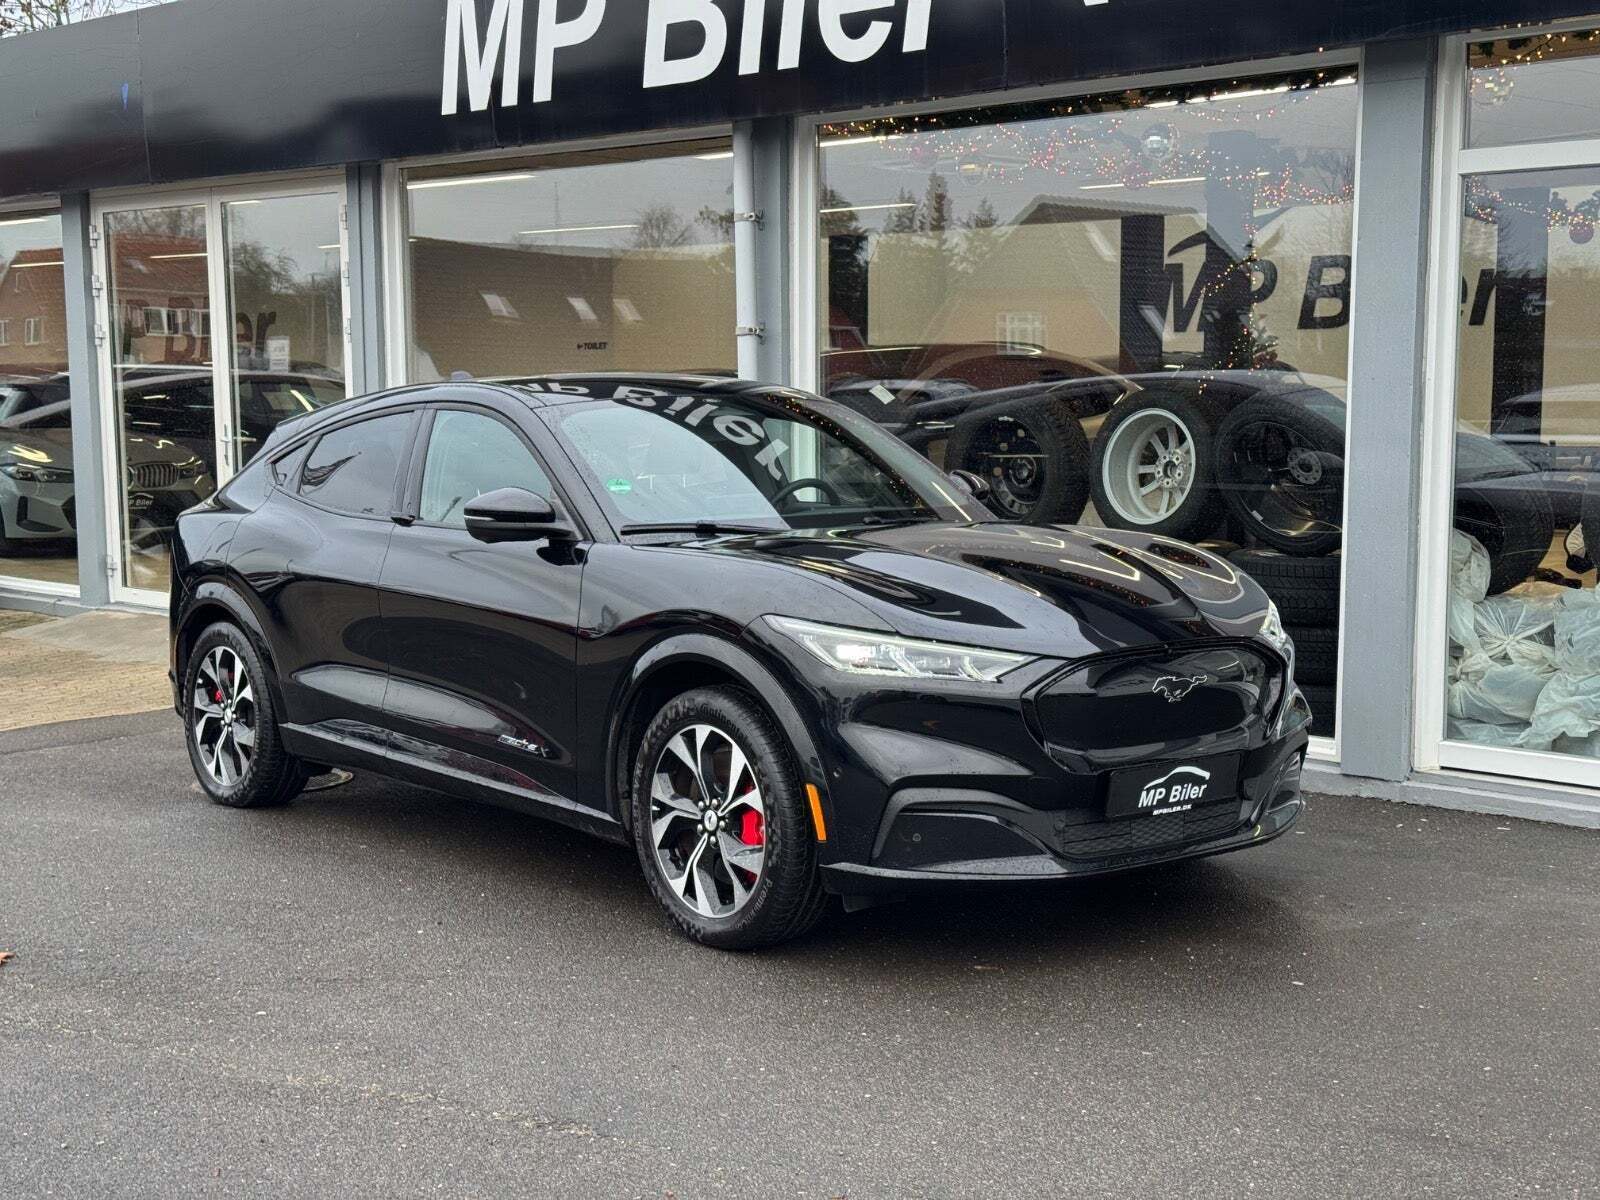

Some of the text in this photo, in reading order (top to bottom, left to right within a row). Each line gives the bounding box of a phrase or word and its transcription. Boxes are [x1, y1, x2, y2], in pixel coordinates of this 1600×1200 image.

[441, 0, 604, 116] MP
[583, 342, 608, 351] TOILET
[1138, 783, 1207, 807] MP Biler
